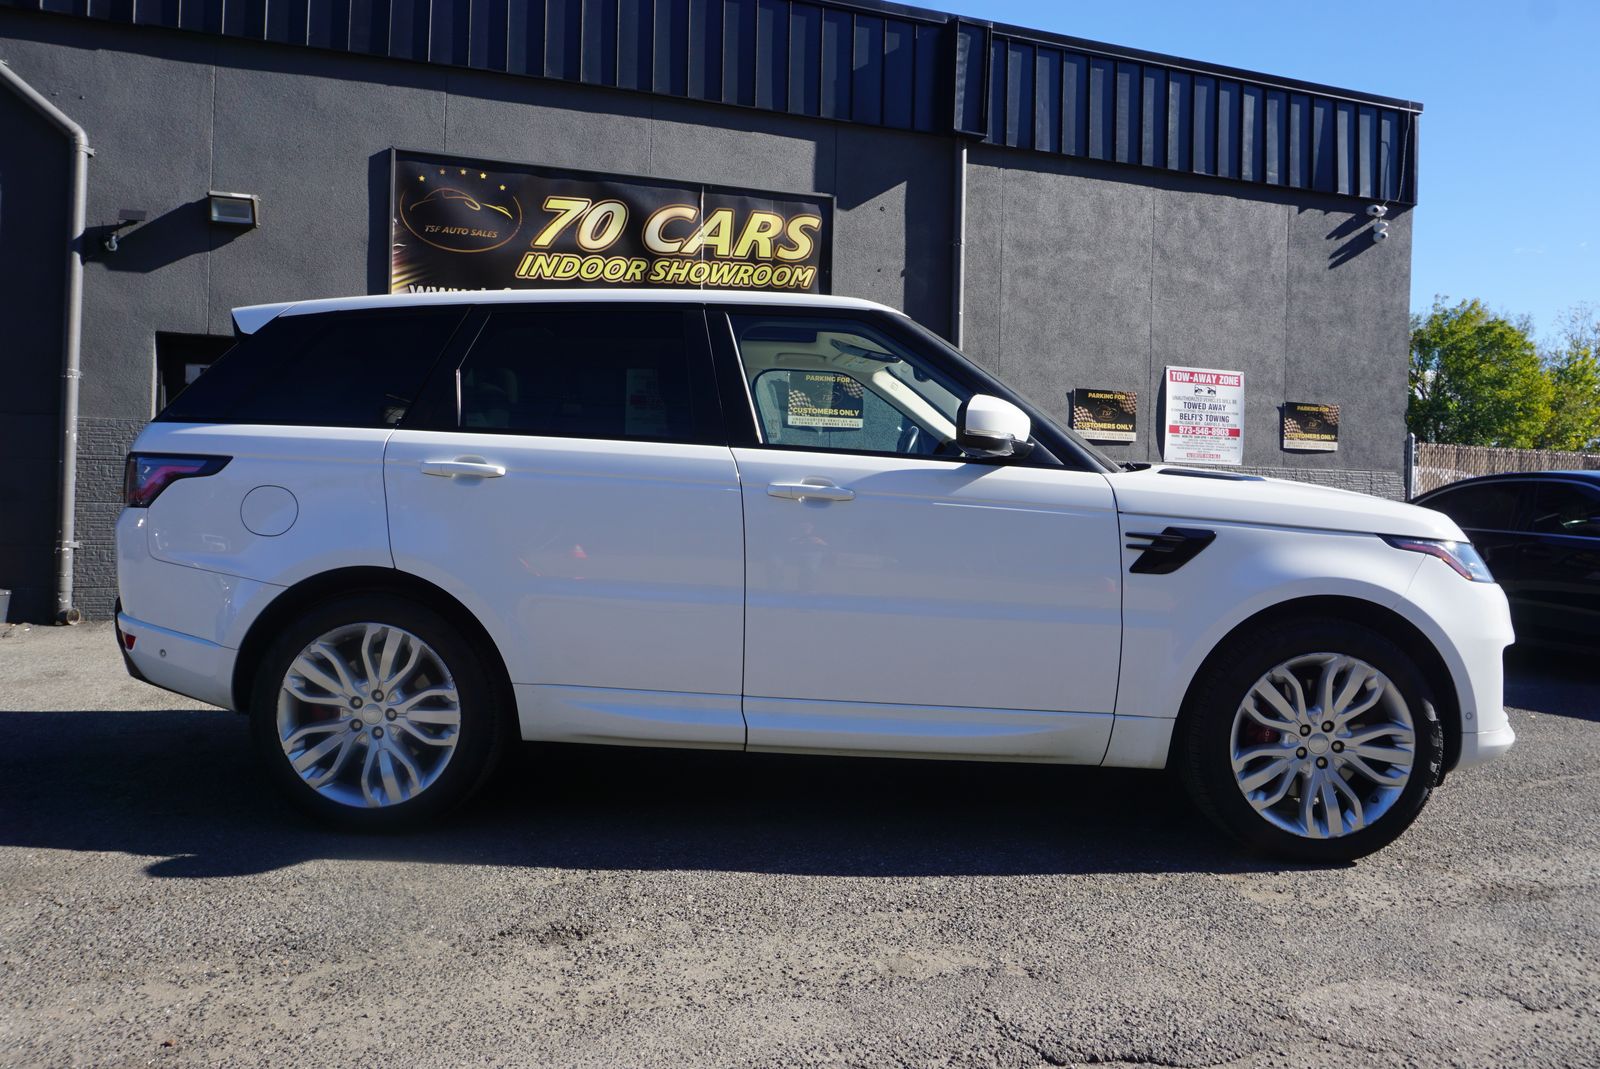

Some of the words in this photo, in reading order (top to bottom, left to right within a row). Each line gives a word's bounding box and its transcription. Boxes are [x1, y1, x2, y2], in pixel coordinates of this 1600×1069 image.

[425, 224, 441, 233] TSF
[442, 226, 469, 236] AUTO
[470, 229, 498, 239] SALES
[530, 195, 629, 252] 70
[641, 204, 822, 263] CARS
[515, 251, 647, 283] INDOOR
[648, 257, 817, 289] SHOWROOM
[806, 374, 836, 382] PARKING
[1171, 371, 1217, 384] TOW-AWAY
[1219, 375, 1239, 386] ZONE
[792, 407, 838, 416] CUSTOMERS
[839, 408, 859, 417] ONLY
[1183, 401, 1207, 410] TOWED
[1208, 403, 1226, 411] AWAY
[1179, 412, 1203, 422] BELFI'S
[1205, 414, 1230, 423] TOWING
